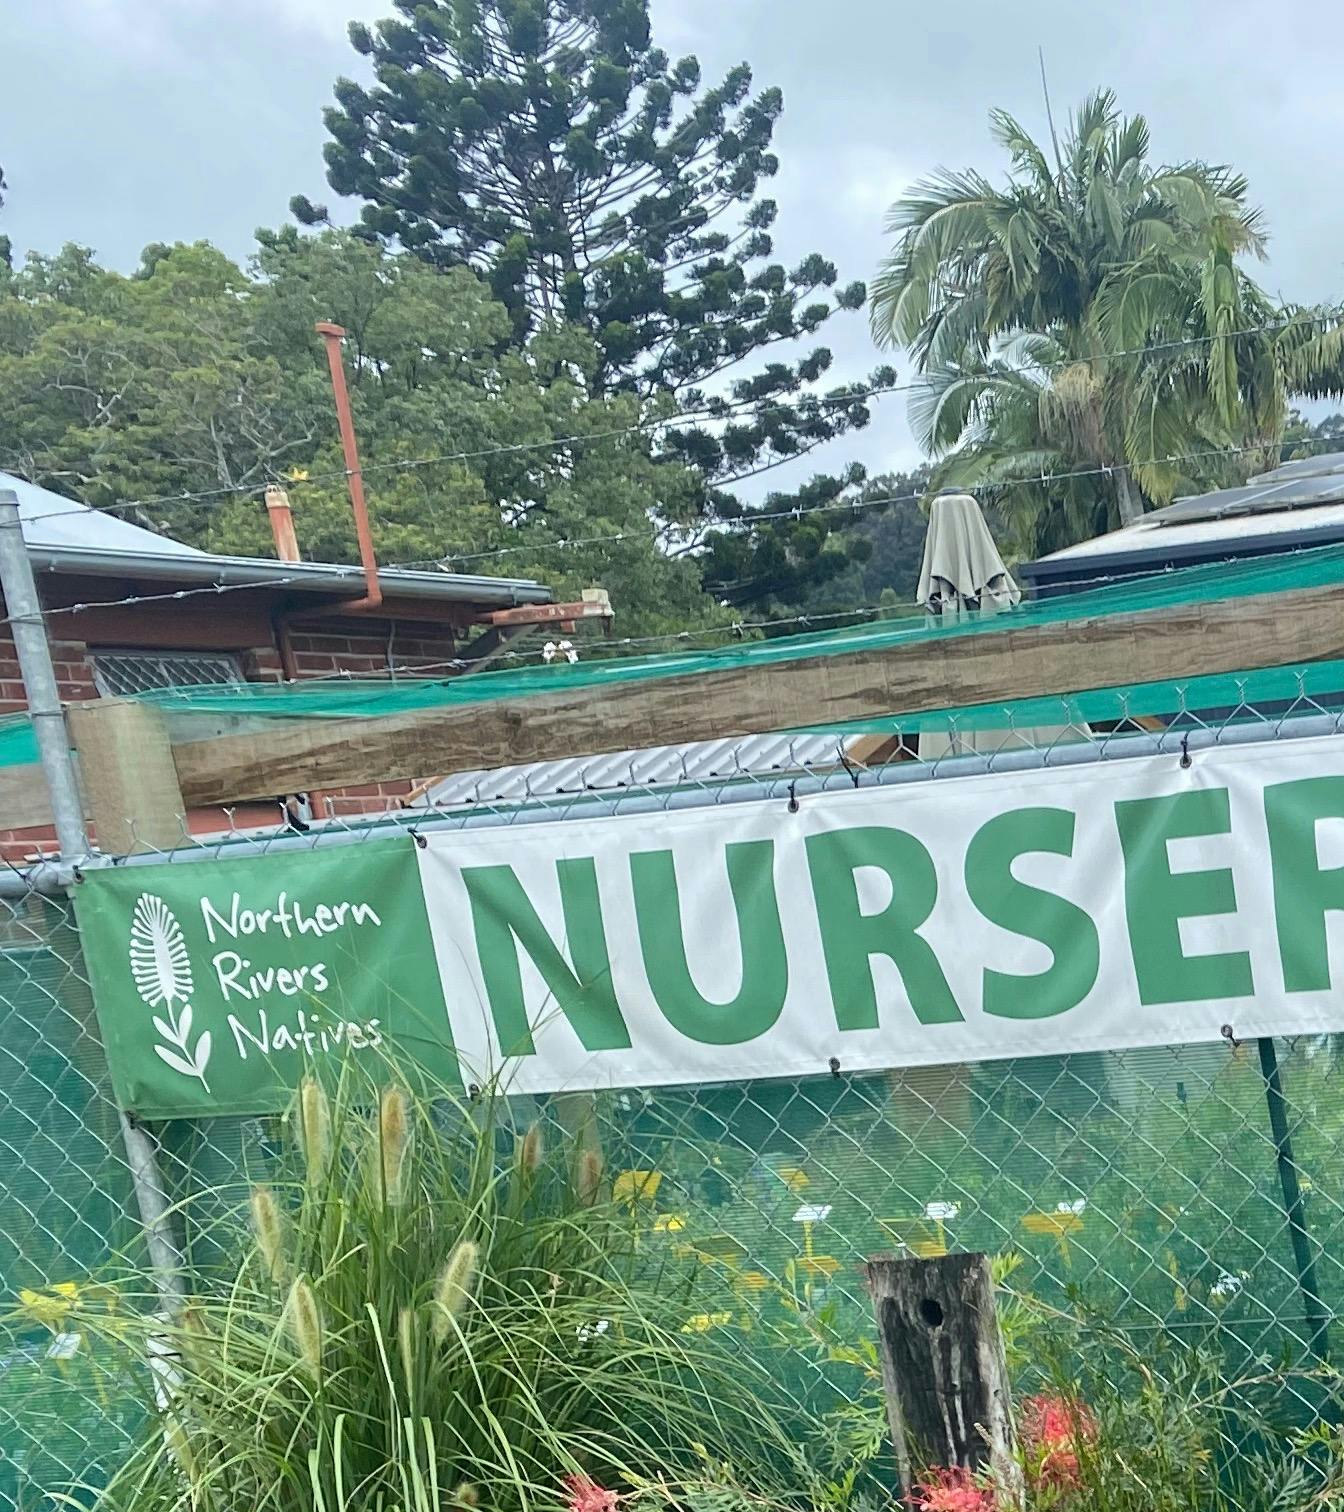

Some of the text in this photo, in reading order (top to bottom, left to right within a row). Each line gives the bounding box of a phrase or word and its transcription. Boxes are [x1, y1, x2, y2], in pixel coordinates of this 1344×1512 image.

[200, 891, 382, 943] Northern
[212, 950, 329, 1001] Rivers
[226, 1008, 384, 1060] Natives
